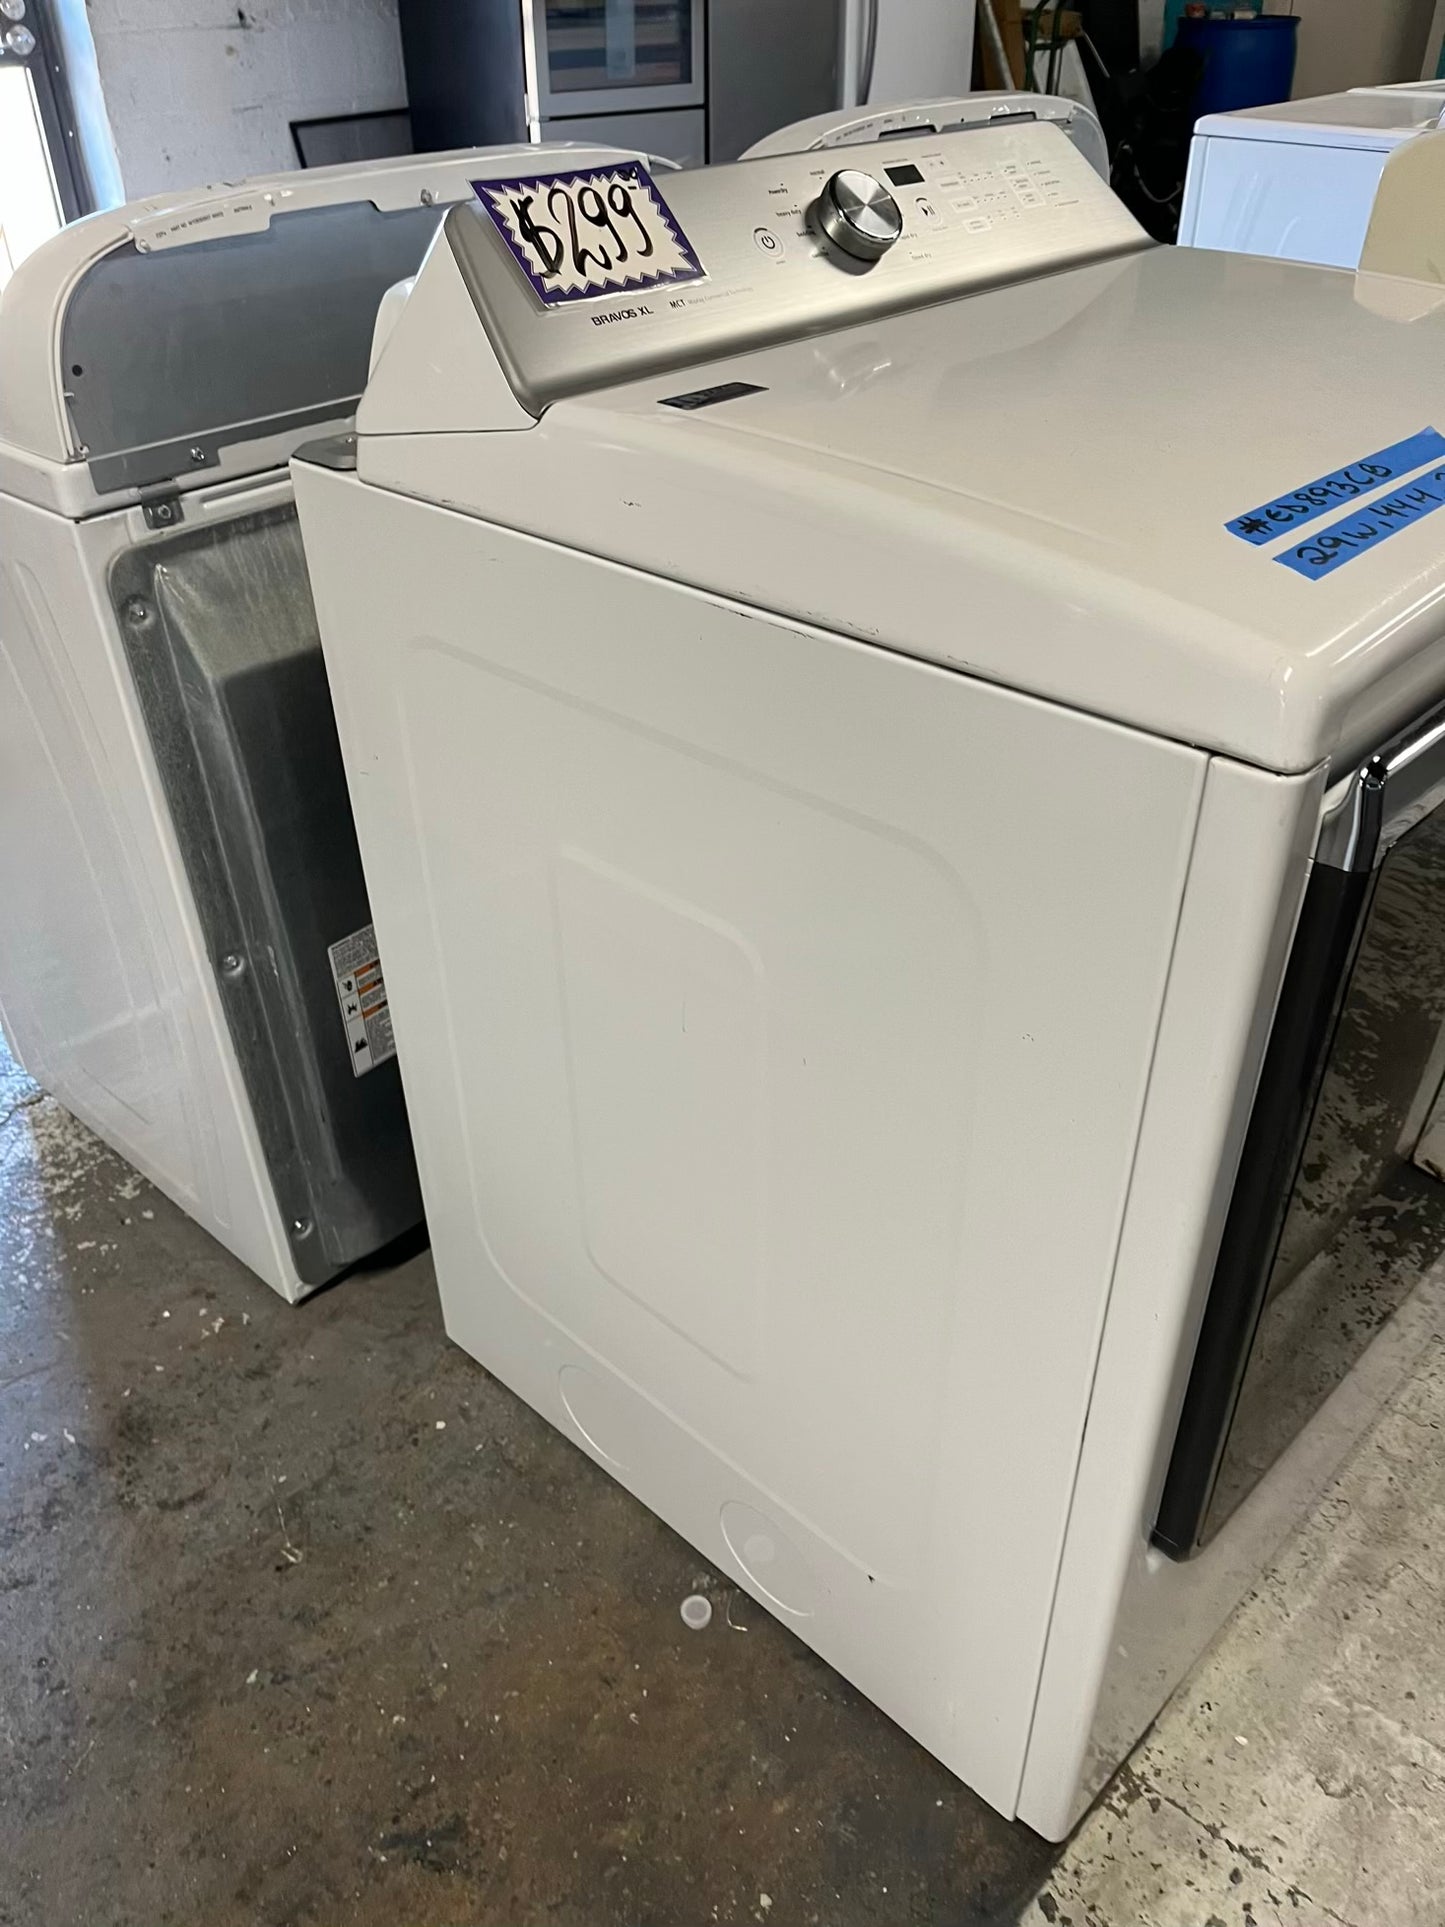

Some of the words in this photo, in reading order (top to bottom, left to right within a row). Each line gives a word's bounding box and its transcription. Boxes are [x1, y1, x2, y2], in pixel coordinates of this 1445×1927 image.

[669, 299, 687, 309] MCT
[591, 308, 638, 327] BRAVOS
[637, 305, 655, 317] XL
